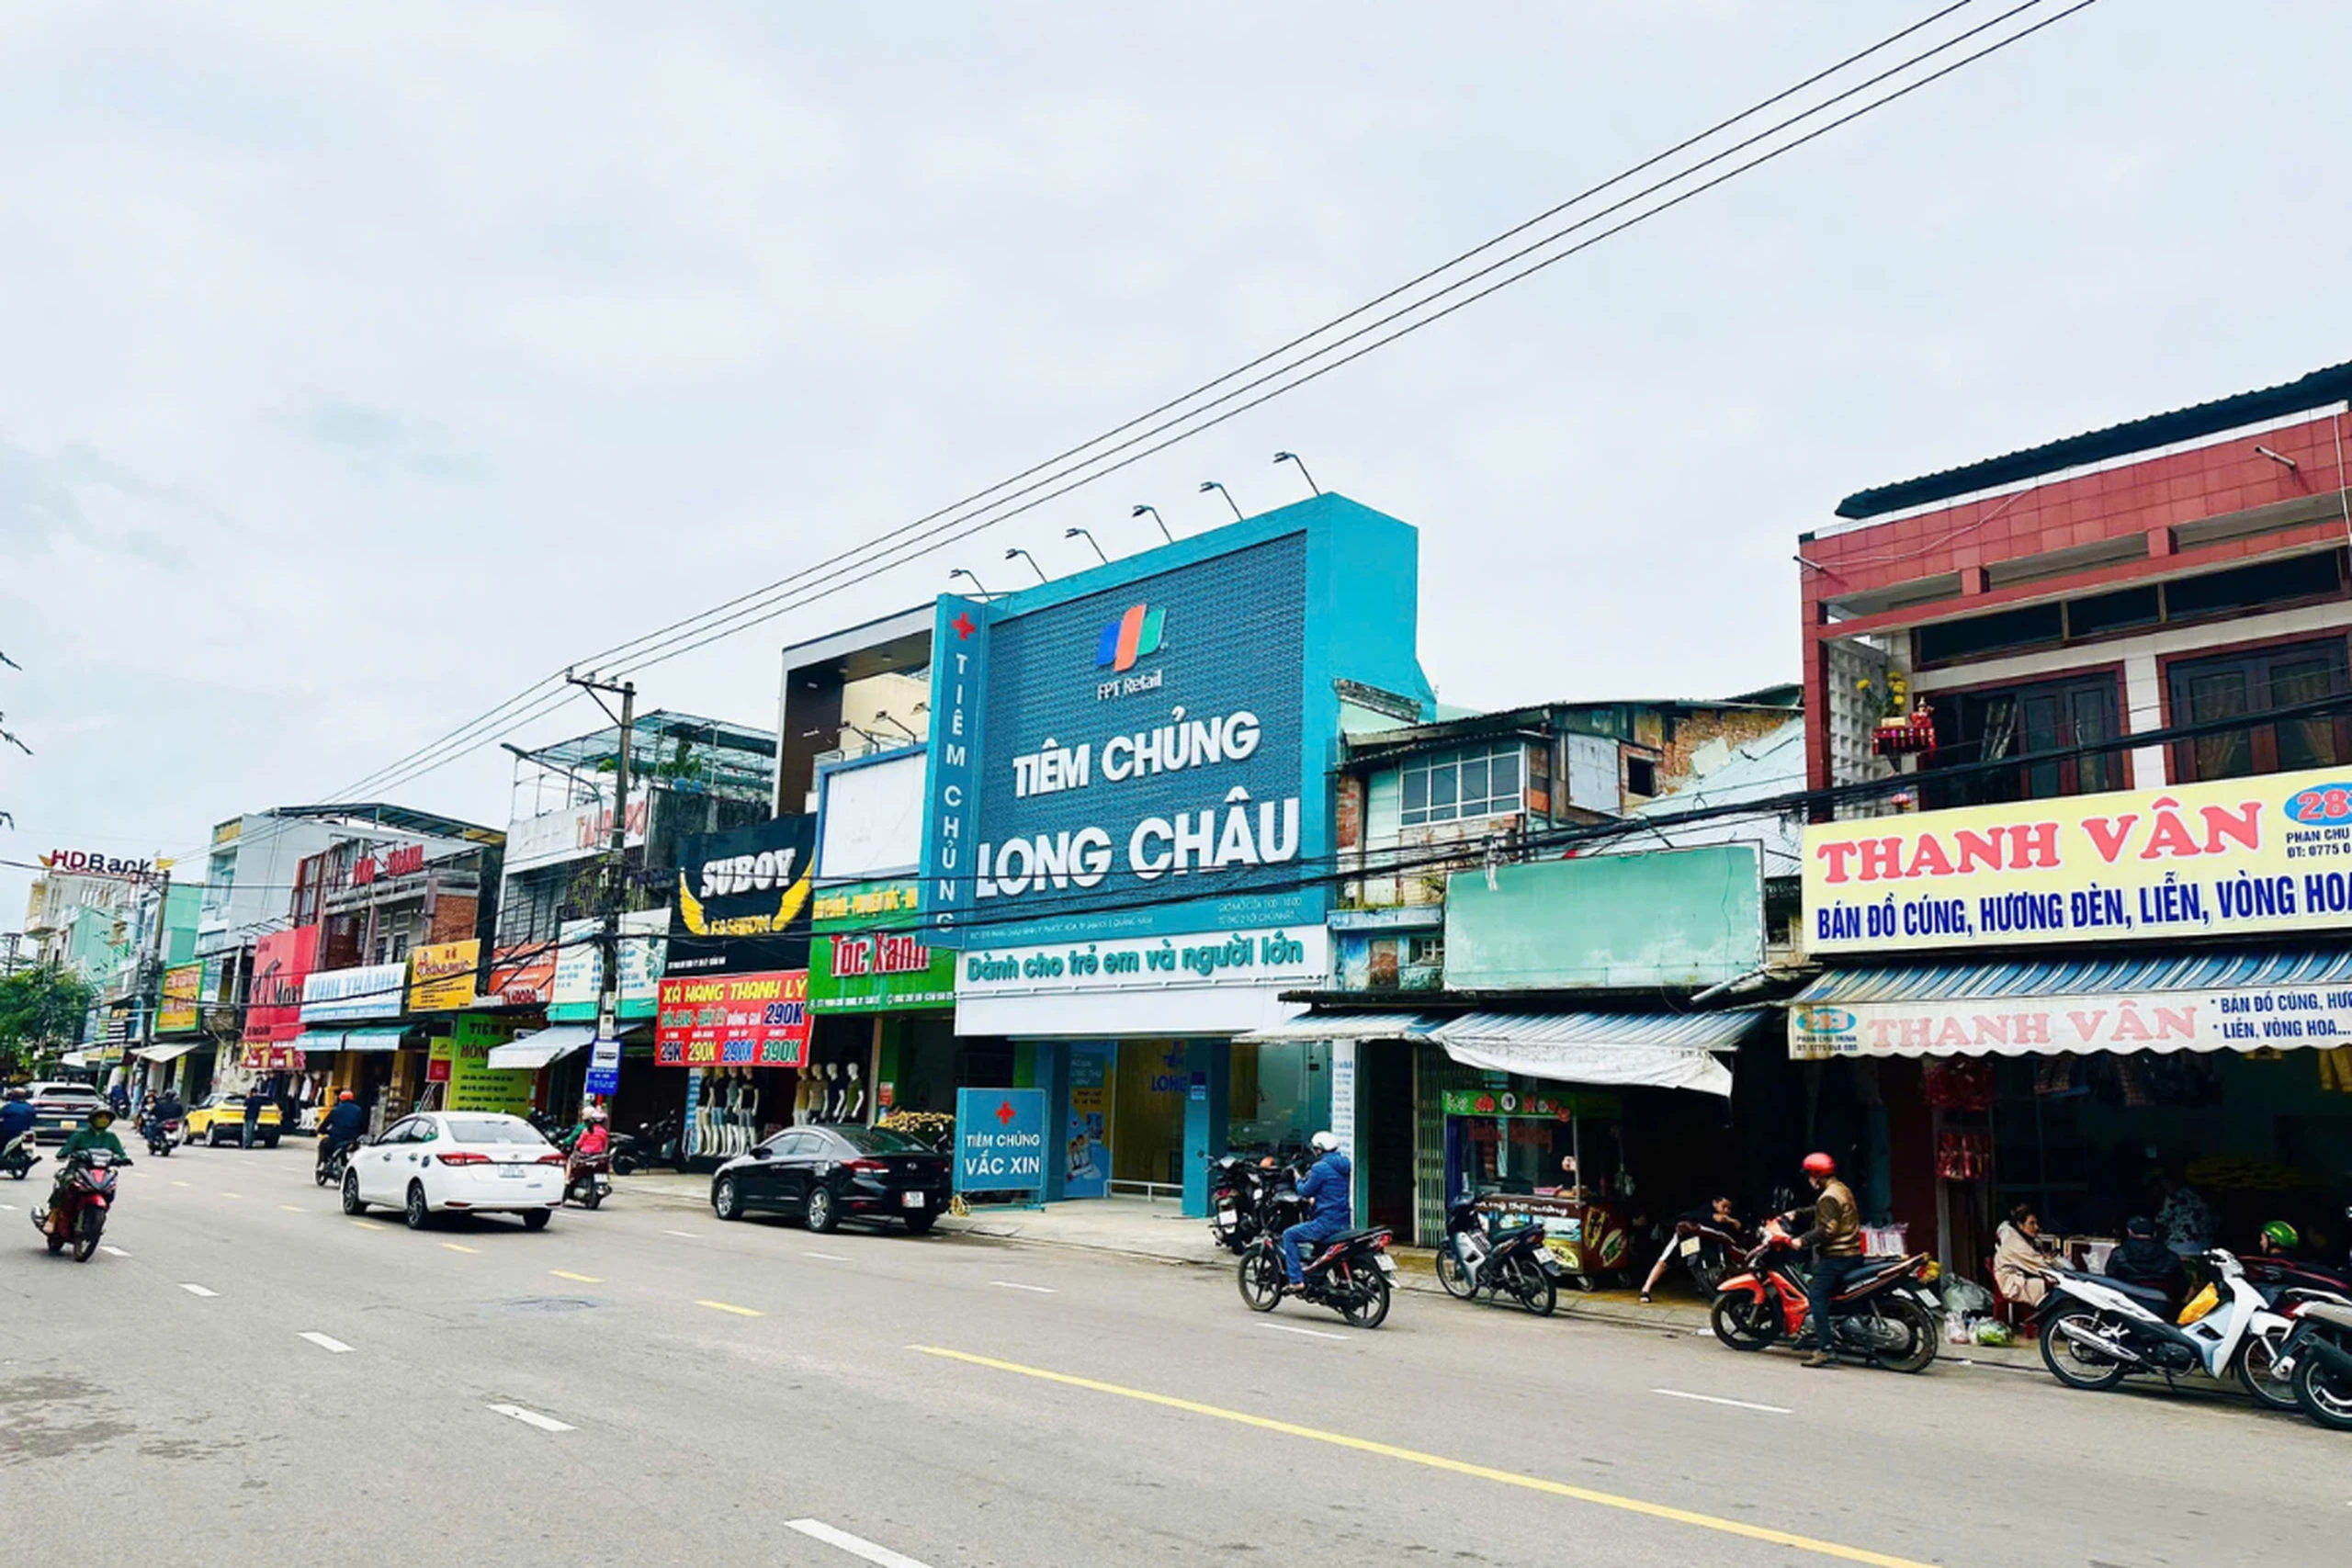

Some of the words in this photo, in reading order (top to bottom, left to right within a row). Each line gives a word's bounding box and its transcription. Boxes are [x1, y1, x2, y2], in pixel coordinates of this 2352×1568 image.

[1097, 680, 1121, 701] FPT
[1123, 669, 1162, 695] Retail
[945, 653, 968, 767] TIÊM
[1012, 738, 1091, 797] TIÊM
[1102, 705, 1261, 781] CHỦNG
[2299, 789, 2352, 820] 28
[976, 827, 1113, 898] LONG
[1129, 785, 1300, 880] CHÂU
[1816, 822, 2061, 884] THANH
[2081, 796, 2262, 863] VÂN
[2286, 830, 2320, 844] PHAN
[2324, 828, 2349, 840] CHU
[2287, 847, 2306, 858] ĐT:
[2308, 843, 2339, 857] 0775
[51, 849, 152, 874] HDBank
[700, 848, 796, 898] SUBOY
[935, 785, 963, 932] CHỦNG
[1817, 900, 1860, 940] BÁN
[1867, 892, 1895, 937] ĐỒ
[1904, 894, 1973, 937] CÚNG,
[1980, 891, 2064, 931] HƯƠNG
[2071, 883, 2132, 930] ĐÈN,
[2139, 871, 2209, 925] LIỄN,
[2216, 870, 2296, 919] VÒNG
[2304, 872, 2352, 913] HO
[710, 914, 772, 935] FASHION
[967, 952, 1020, 982] Dành
[1023, 952, 1064, 978] cho
[1069, 943, 1099, 976] trẻ
[1102, 950, 1139, 974] em
[1146, 939, 1177, 972] và
[1182, 932, 1254, 976] người
[1261, 930, 1303, 964] lớn
[684, 979, 725, 1003] HÀNG
[729, 980, 782, 1000] THANH
[785, 976, 808, 998] LÝ
[2221, 993, 2250, 1013] BÁN
[764, 1002, 805, 1025] 290K
[1866, 1012, 2050, 1048] THANH
[2067, 999, 2198, 1042] VÂN
[2263, 1017, 2302, 1037] VÒNG
[761, 1039, 801, 1063] 390K
[967, 1131, 993, 1147] TIÊM
[996, 1130, 1041, 1147] CHỦNG
[965, 1148, 1004, 1176] VẮC
[1010, 1156, 1040, 1174] XIN
